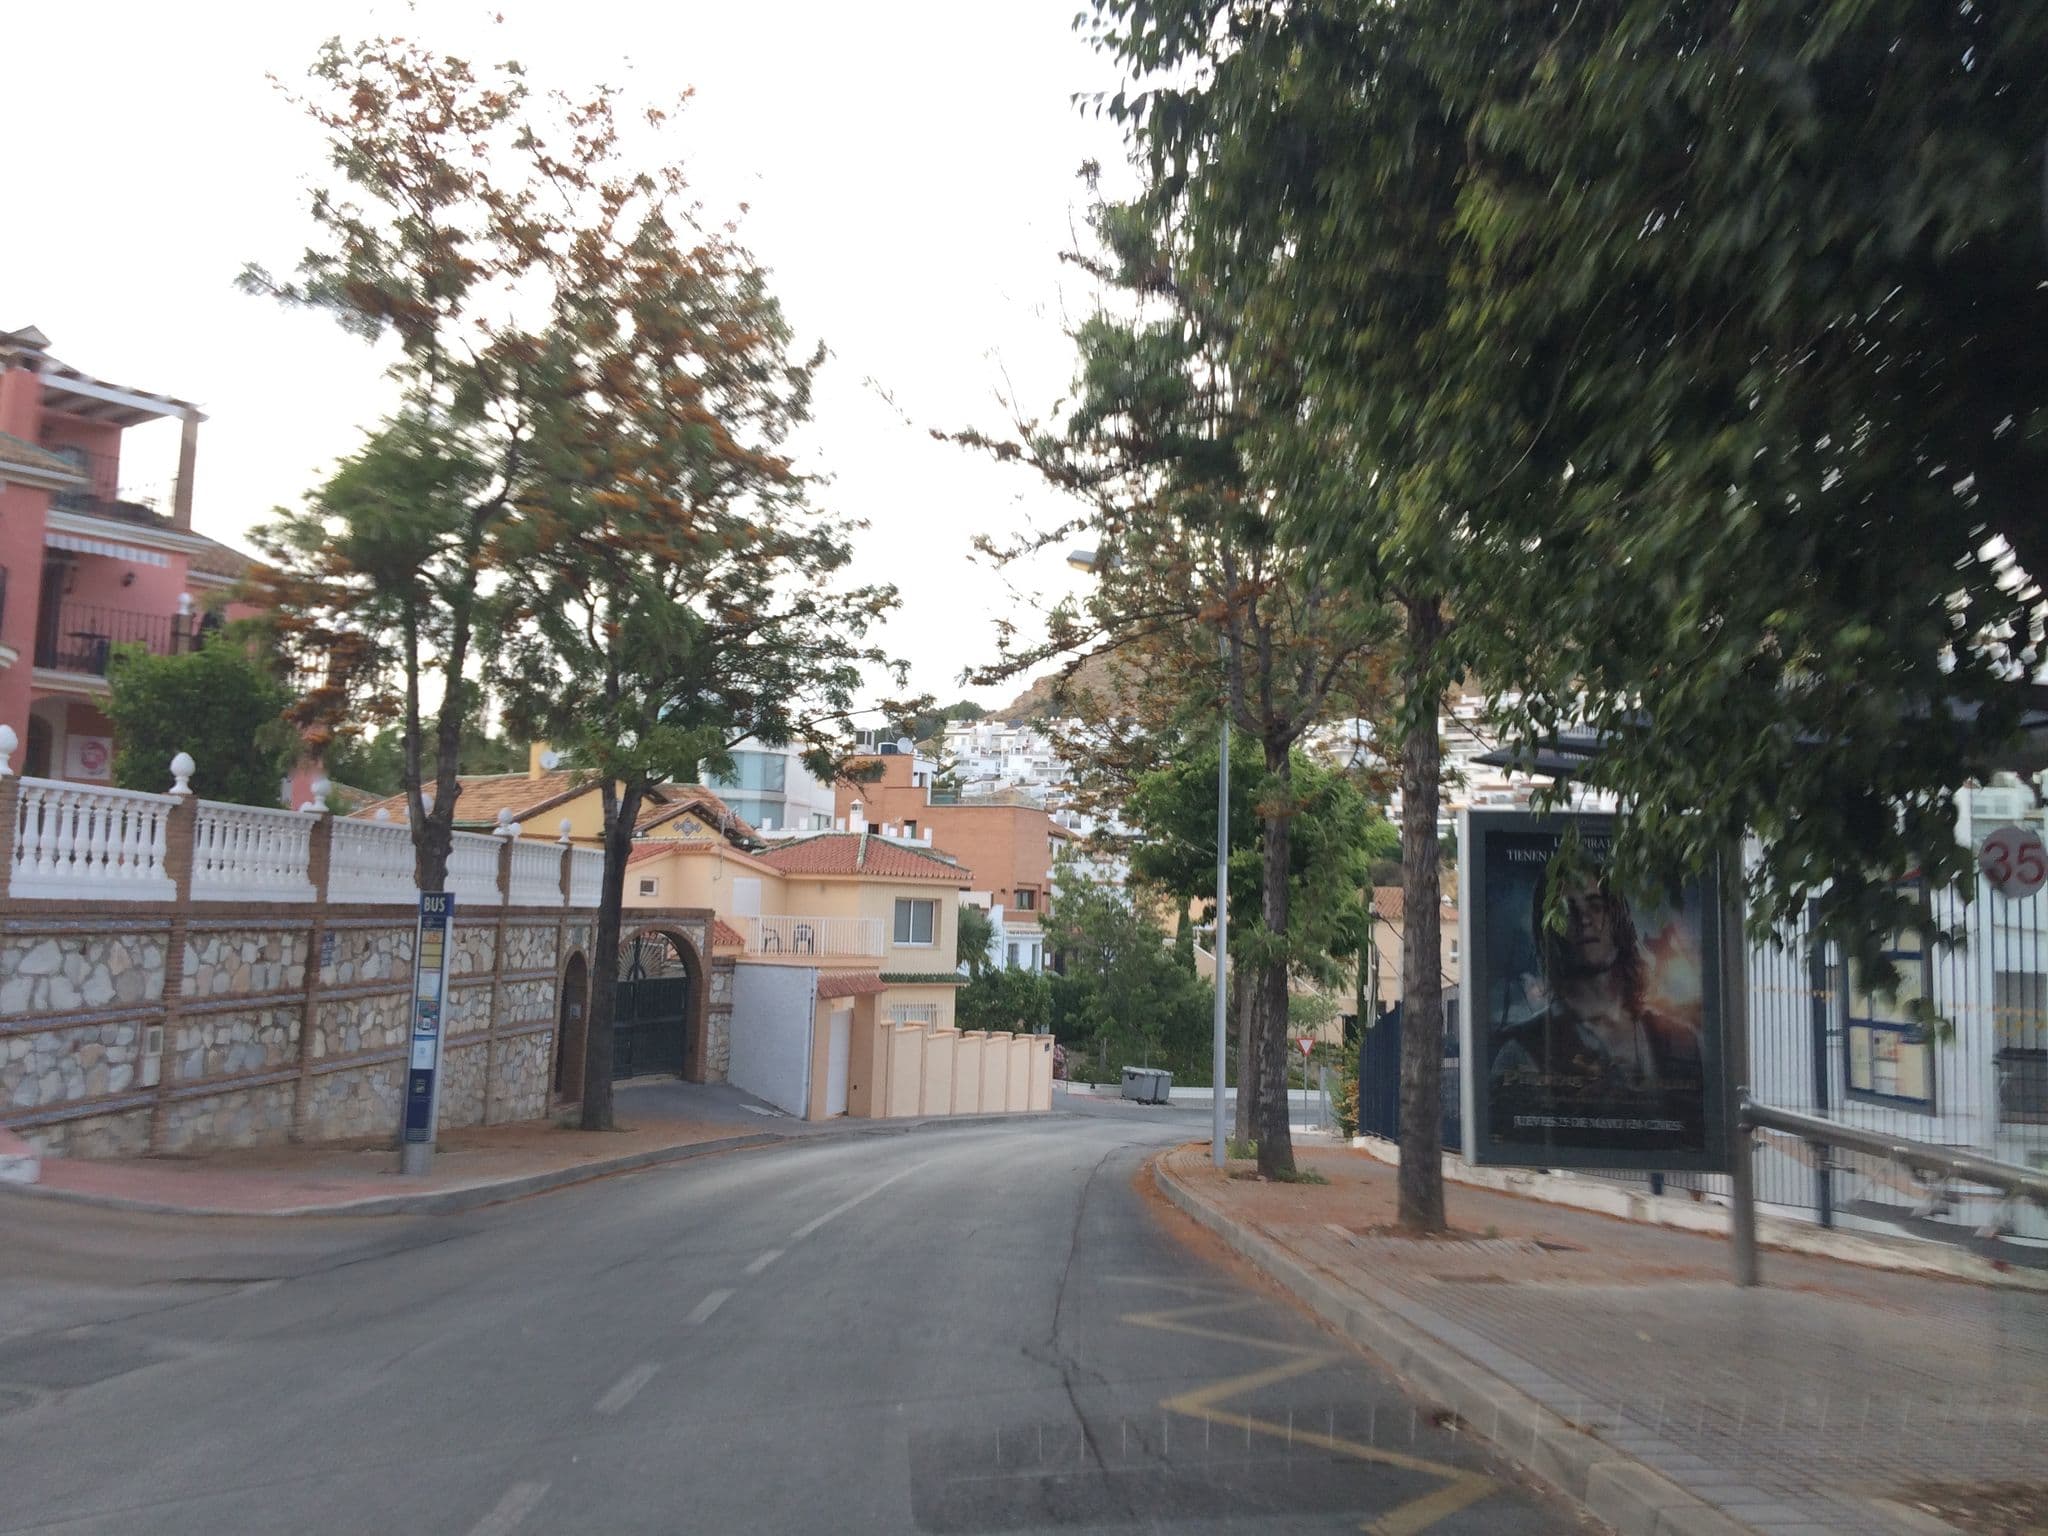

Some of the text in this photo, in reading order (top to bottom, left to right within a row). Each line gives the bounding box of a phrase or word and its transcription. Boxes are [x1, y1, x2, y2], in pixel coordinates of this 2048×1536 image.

[1506, 849, 1547, 862] TIENEN
[1984, 841, 2045, 885] 35
[424, 896, 446, 912] BUS
